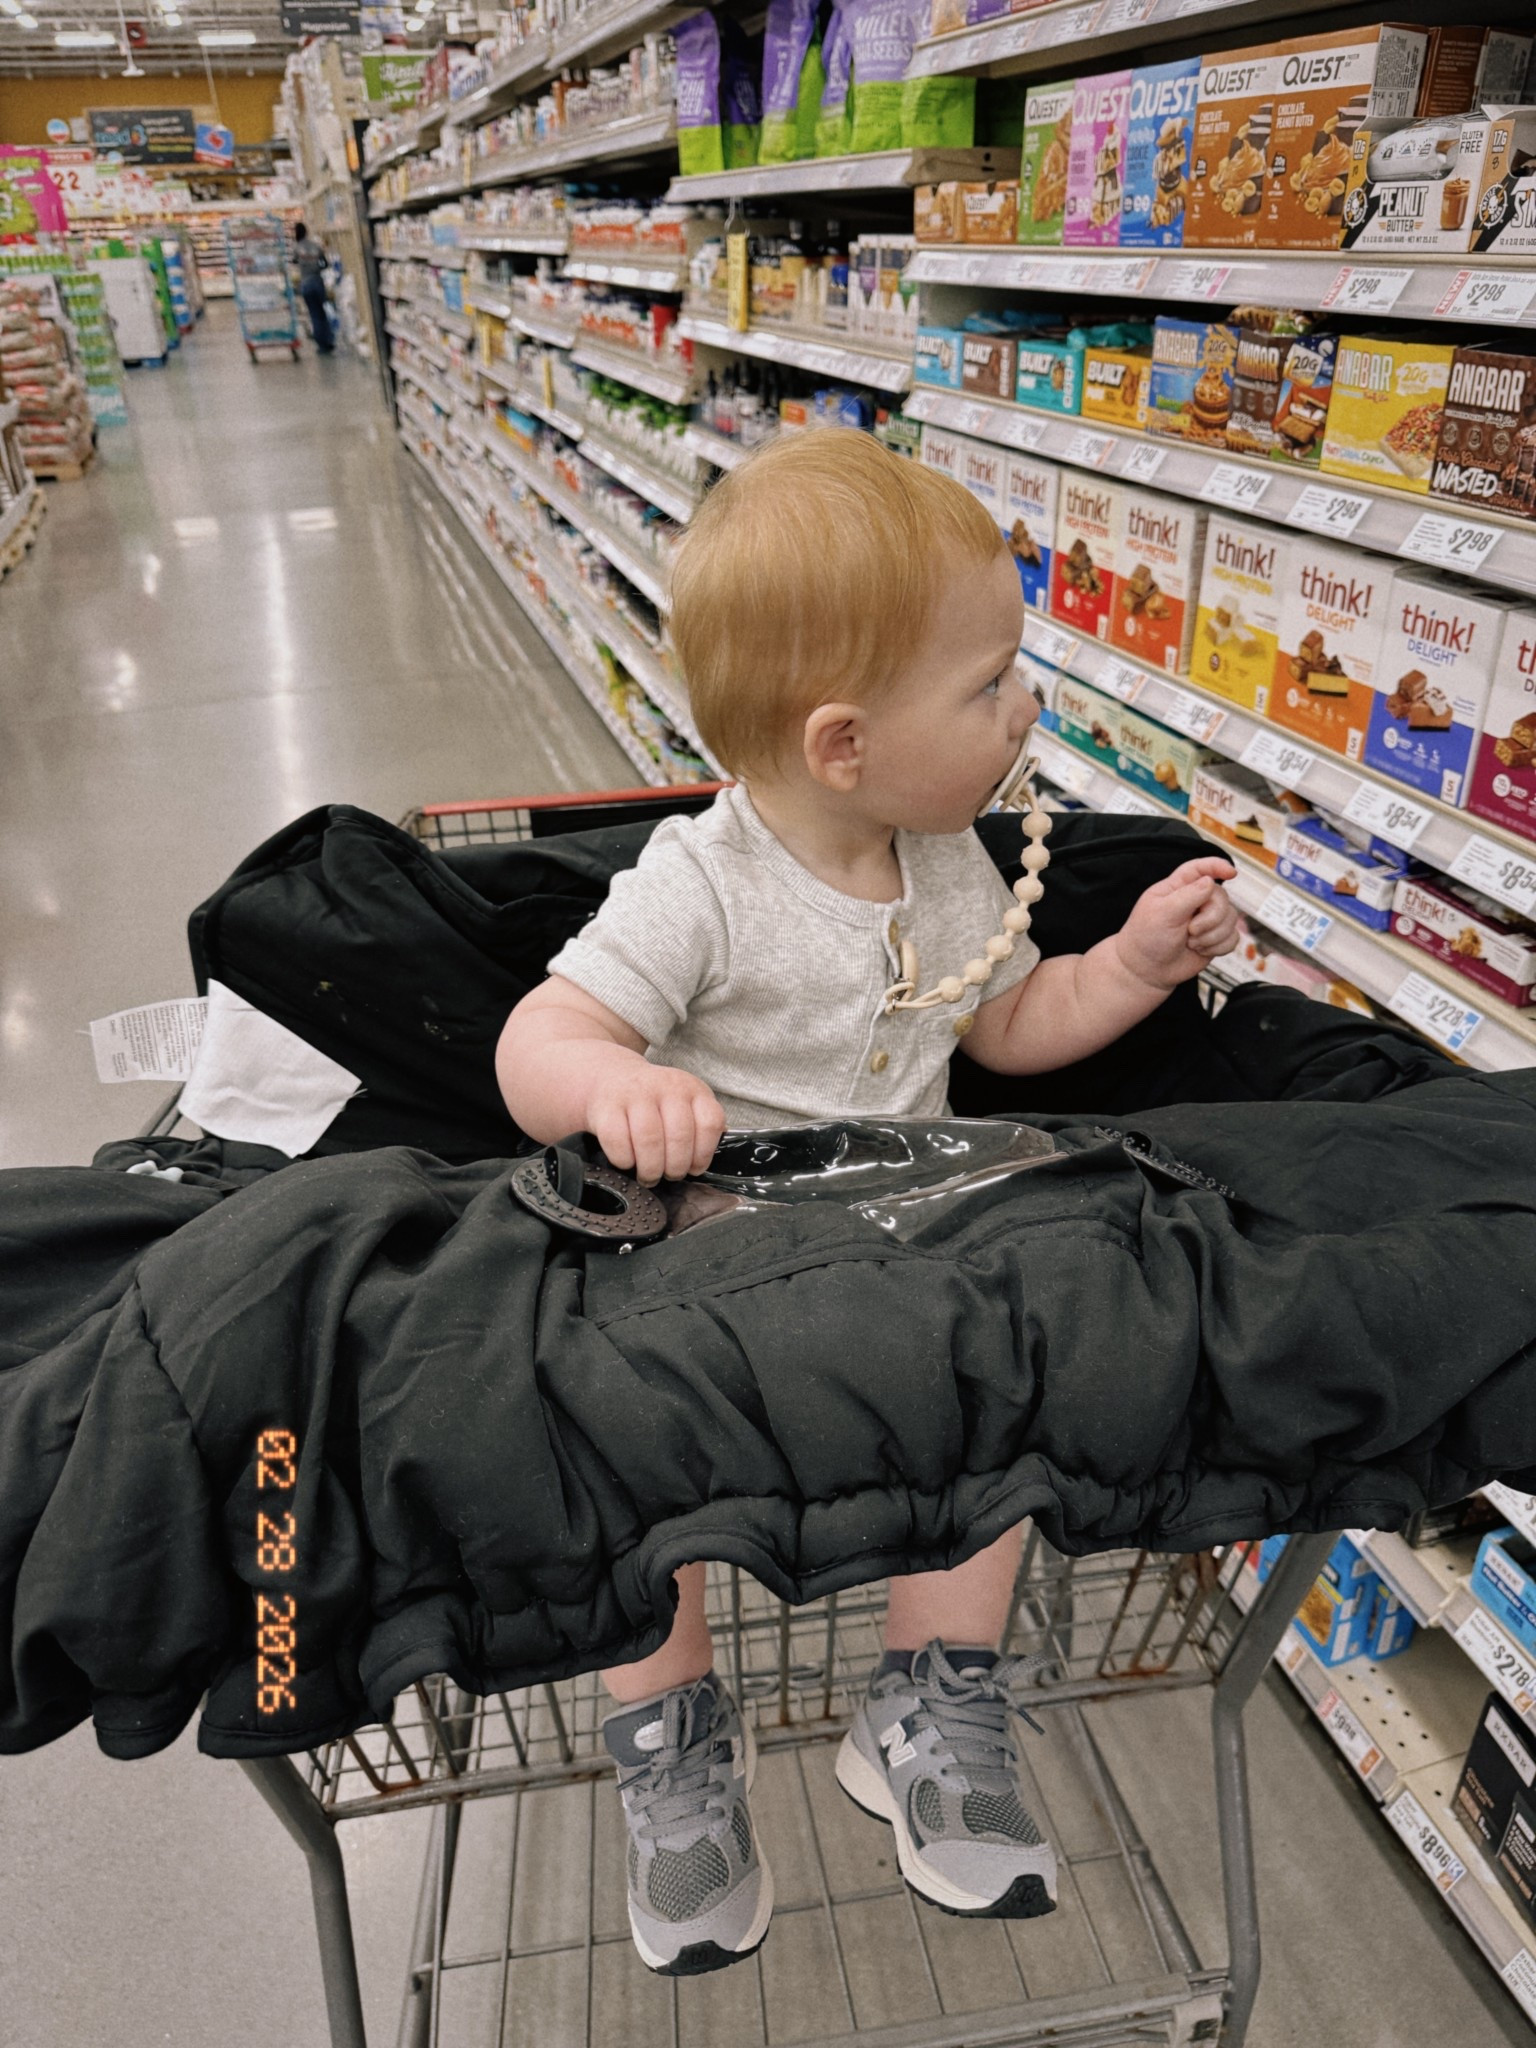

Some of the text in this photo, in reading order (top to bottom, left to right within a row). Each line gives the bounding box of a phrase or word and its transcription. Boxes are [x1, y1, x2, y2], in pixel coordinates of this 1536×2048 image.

[302, 22, 350, 32] Magnesium
[1204, 67, 1256, 96] QUEST
[1283, 55, 1346, 87] QUEST
[1028, 98, 1059, 121] QUEST
[1072, 85, 1132, 126] QUEST
[1129, 75, 1199, 120] QUEST
[1278, 102, 1306, 115] CHOCOLATE
[1276, 114, 1315, 129] PEANUT BUTTER
[1462, 130, 1484, 143] GLUTEN
[1353, 139, 1366, 153] 17G
[1460, 140, 1483, 153] FREE
[1493, 130, 1508, 146] 17G
[1377, 186, 1429, 218] PEANUT
[1386, 219, 1414, 232] BUTTER
[1348, 277, 1382, 300] $298
[1440, 276, 1464, 310] NEW!
[1467, 283, 1506, 307] $298
[963, 341, 993, 365] BUILT
[1020, 350, 1053, 374] BUILT
[1293, 356, 1319, 370] 20G
[1086, 360, 1126, 386] BUILT
[1337, 349, 1393, 391] ANABAR
[1449, 362, 1526, 413] ANABAR
[1011, 466, 1048, 503] think!
[1234, 474, 1266, 497] $298
[1432, 462, 1498, 497] WASTED
[1067, 485, 1112, 524] think!
[1326, 497, 1363, 522] $298
[1129, 506, 1180, 549] think!
[1447, 528, 1494, 555] $298
[1216, 532, 1276, 580] think!
[1301, 566, 1373, 619] think!
[1306, 602, 1356, 632] DELIGHT
[1402, 604, 1476, 654] think!
[1407, 638, 1458, 667] DELIGHT
[1120, 724, 1153, 754] think!
[1195, 775, 1235, 813] think!
[1383, 801, 1422, 831] $854
[1287, 832, 1321, 862] think!
[1404, 888, 1447, 924] think!
[1427, 995, 1465, 1027] $228
[1493, 1644, 1531, 1688] $278
[1418, 1825, 1450, 1868] $896
